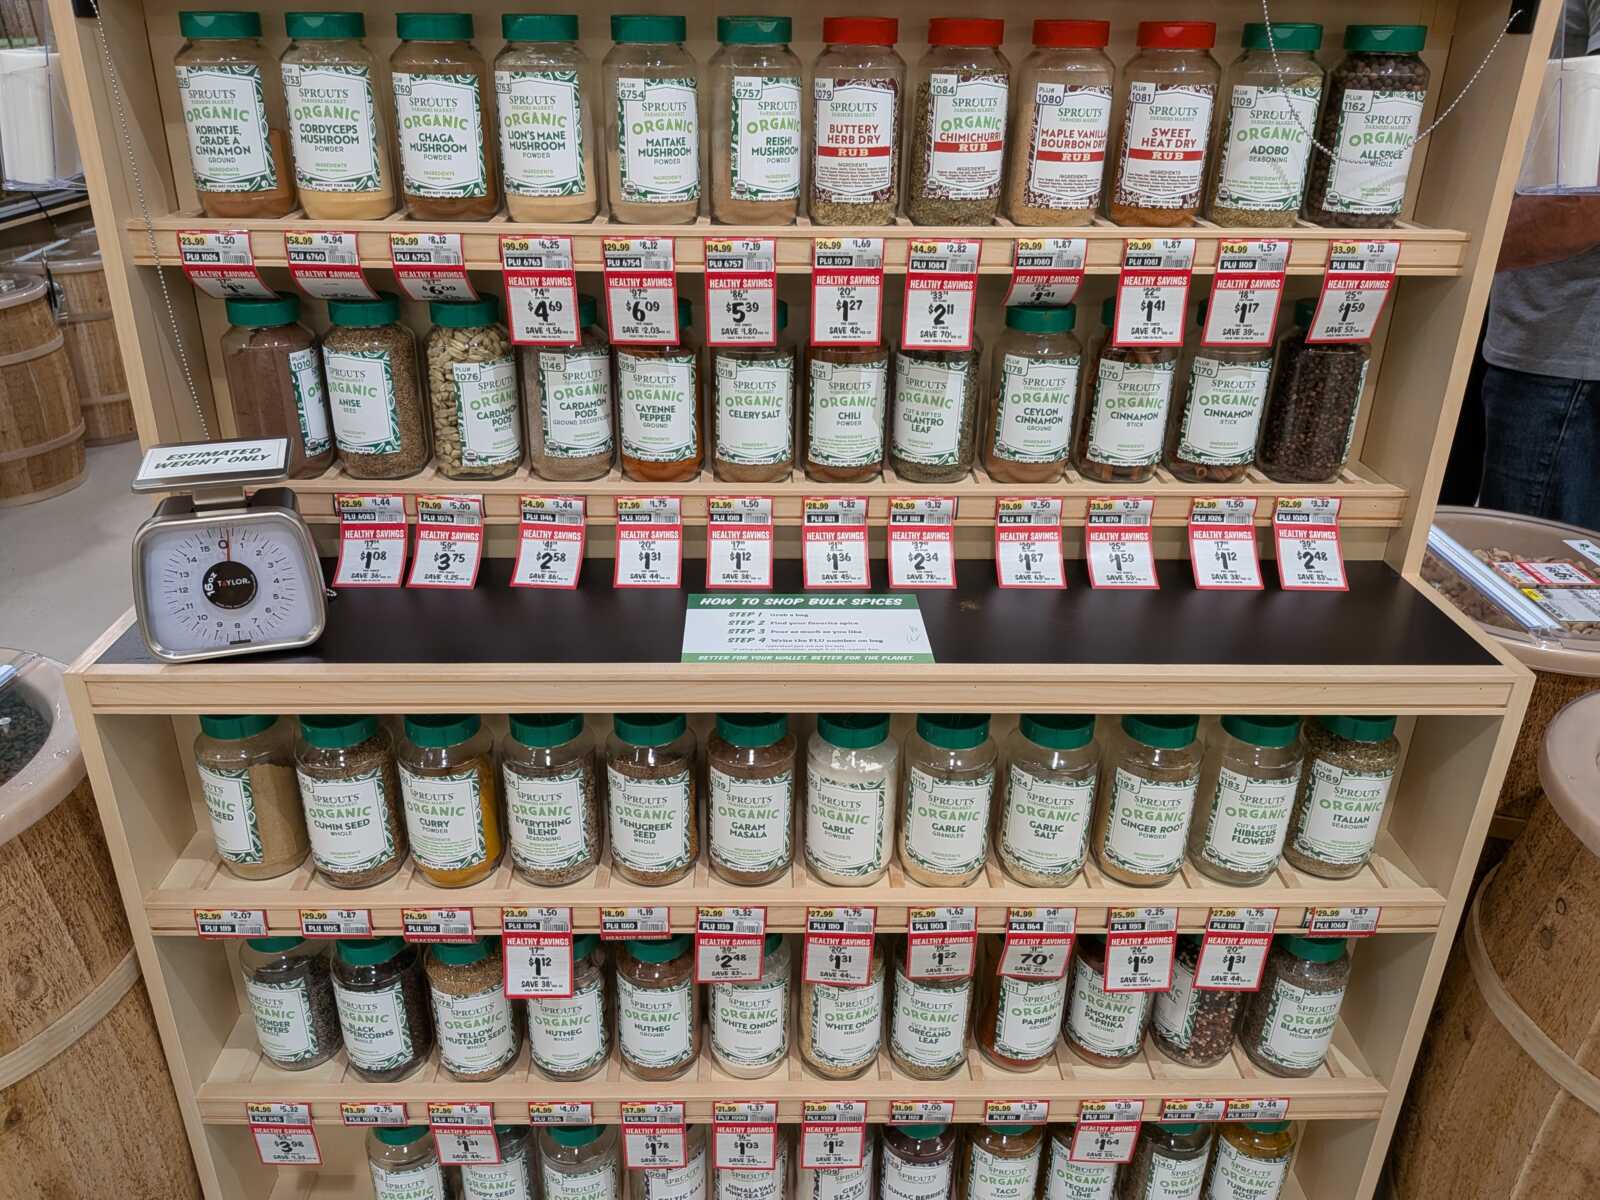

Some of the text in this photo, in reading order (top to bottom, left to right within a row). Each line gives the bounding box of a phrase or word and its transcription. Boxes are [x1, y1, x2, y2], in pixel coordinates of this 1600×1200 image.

[736, 89, 760, 98] 6757
[933, 85, 954, 94] 1084
[188, 90, 236, 99] SPROUTS
[620, 90, 644, 99] 6754
[1132, 93, 1151, 102] 1081
[1038, 95, 1061, 104] 1080
[1233, 97, 1252, 106] 1109
[1149, 106, 1198, 116] SPROUTS
[1344, 102, 1365, 111] 1162
[186, 106, 249, 122] ORGANIC
[294, 106, 360, 121] ORGANIC
[632, 119, 693, 134] ORGANIC
[940, 116, 1001, 131] ORGANIC
[300, 124, 357, 133] CORDYCEPS
[829, 124, 878, 134] BUTTERY
[1151, 128, 1191, 137] SWEET
[419, 133, 454, 142] CHAGA
[537, 131, 566, 140] MANE
[939, 132, 1001, 142] CHIMICHURRI
[1041, 129, 1075, 138] MAPLE
[200, 136, 239, 145] GRADE A
[300, 134, 359, 144] MUSHROOM
[646, 137, 686, 146] MAITAKE
[766, 136, 792, 146] REISHI
[827, 134, 881, 145] HERB DRY
[1141, 138, 1197, 148] HEAT DRY
[410, 143, 467, 153] MUSHROOM
[958, 143, 988, 152] RUB
[1041, 139, 1090, 149] BOURBON
[196, 145, 251, 156] CINNAMON
[638, 147, 692, 156] MUSHROOM
[751, 147, 799, 157] MUSHROOM
[837, 148, 869, 156] RUB
[1152, 151, 1183, 159] RUB
[1250, 146, 1289, 155] ADOBO
[208, 156, 236, 164] GROUND
[1062, 153, 1091, 161] RUB
[509, 277, 572, 286] HEALTHY SAVINGS
[710, 279, 772, 288] HEALTHY SAVINGS
[817, 275, 879, 285] HEALTHY SAVINGS
[1124, 276, 1187, 285] HEALTHY SAVINGS
[1328, 280, 1390, 289] HEALTHY SAVINGS
[1195, 366, 1213, 375] 1170
[455, 373, 478, 381] 1076
[734, 381, 776, 389] SPROUTS
[627, 389, 684, 403] ORGANIC
[1011, 393, 1070, 405] ORGANIC
[1199, 395, 1259, 406] ORGANIC
[339, 399, 360, 408] ANISE
[725, 395, 783, 408] ORGANIC
[819, 396, 877, 409] ORGANIC
[636, 404, 676, 413] CAYENNE
[1024, 407, 1058, 416] CEYLON
[640, 414, 671, 422] PEPPER
[729, 410, 780, 418] CELERY SALT
[838, 411, 861, 420] CHILI
[1204, 409, 1253, 418] CINNAMON
[492, 416, 512, 426] PODS
[902, 414, 944, 426] CILANTRO
[1015, 416, 1063, 425] CINNAMON
[911, 425, 931, 433] LEAF
[167, 448, 261, 461] ESTIMATED
[154, 454, 271, 469] WEIGHT ONLY
[621, 530, 679, 539] HEALTHY SAVINGS
[1279, 530, 1336, 539] HEALTHY SAVINGS
[308, 806, 371, 818] ORGANIC
[512, 806, 572, 817] ORGANIC
[918, 807, 980, 821] ORGANIC
[1121, 808, 1185, 822] ORGANIC
[419, 818, 449, 827] CURRY
[515, 817, 571, 827] EVERYTHING
[620, 818, 672, 831] FENUGREEK
[1333, 815, 1369, 825] ITALIAN
[314, 819, 370, 831] CUMIN SEED
[732, 822, 766, 831] GARAM
[822, 823, 854, 834] GARLIC
[932, 823, 966, 832] GARLIC
[1029, 821, 1064, 833] GARLIC
[1121, 818, 1184, 832] GINGER ROOT
[527, 827, 558, 835] BLEND
[633, 831, 656, 839] SEED
[730, 830, 767, 839] MASALA
[1034, 830, 1056, 840] SALT
[1234, 827, 1276, 838] HIBISCUS
[1232, 836, 1275, 846] FLOWERS
[507, 938, 569, 946] HEALTHY SAVINGS
[624, 1009, 680, 1022] ORGANIC
[720, 1009, 778, 1020] ORGANIC
[1085, 1007, 1125, 1022] SMOKED
[445, 1013, 503, 1030] ORGANIC
[721, 1017, 778, 1029] WHITE ONION
[1084, 1013, 1123, 1028] PAPRIKA
[634, 1023, 670, 1032] NUTMEG
[445, 1027, 506, 1046] MUSTARD SEED
[457, 1027, 493, 1038] YELLOW
[546, 1028, 582, 1038] NUTMEG
[908, 1028, 951, 1038] OREGANO
[995, 1187, 1017, 1195] TACO
